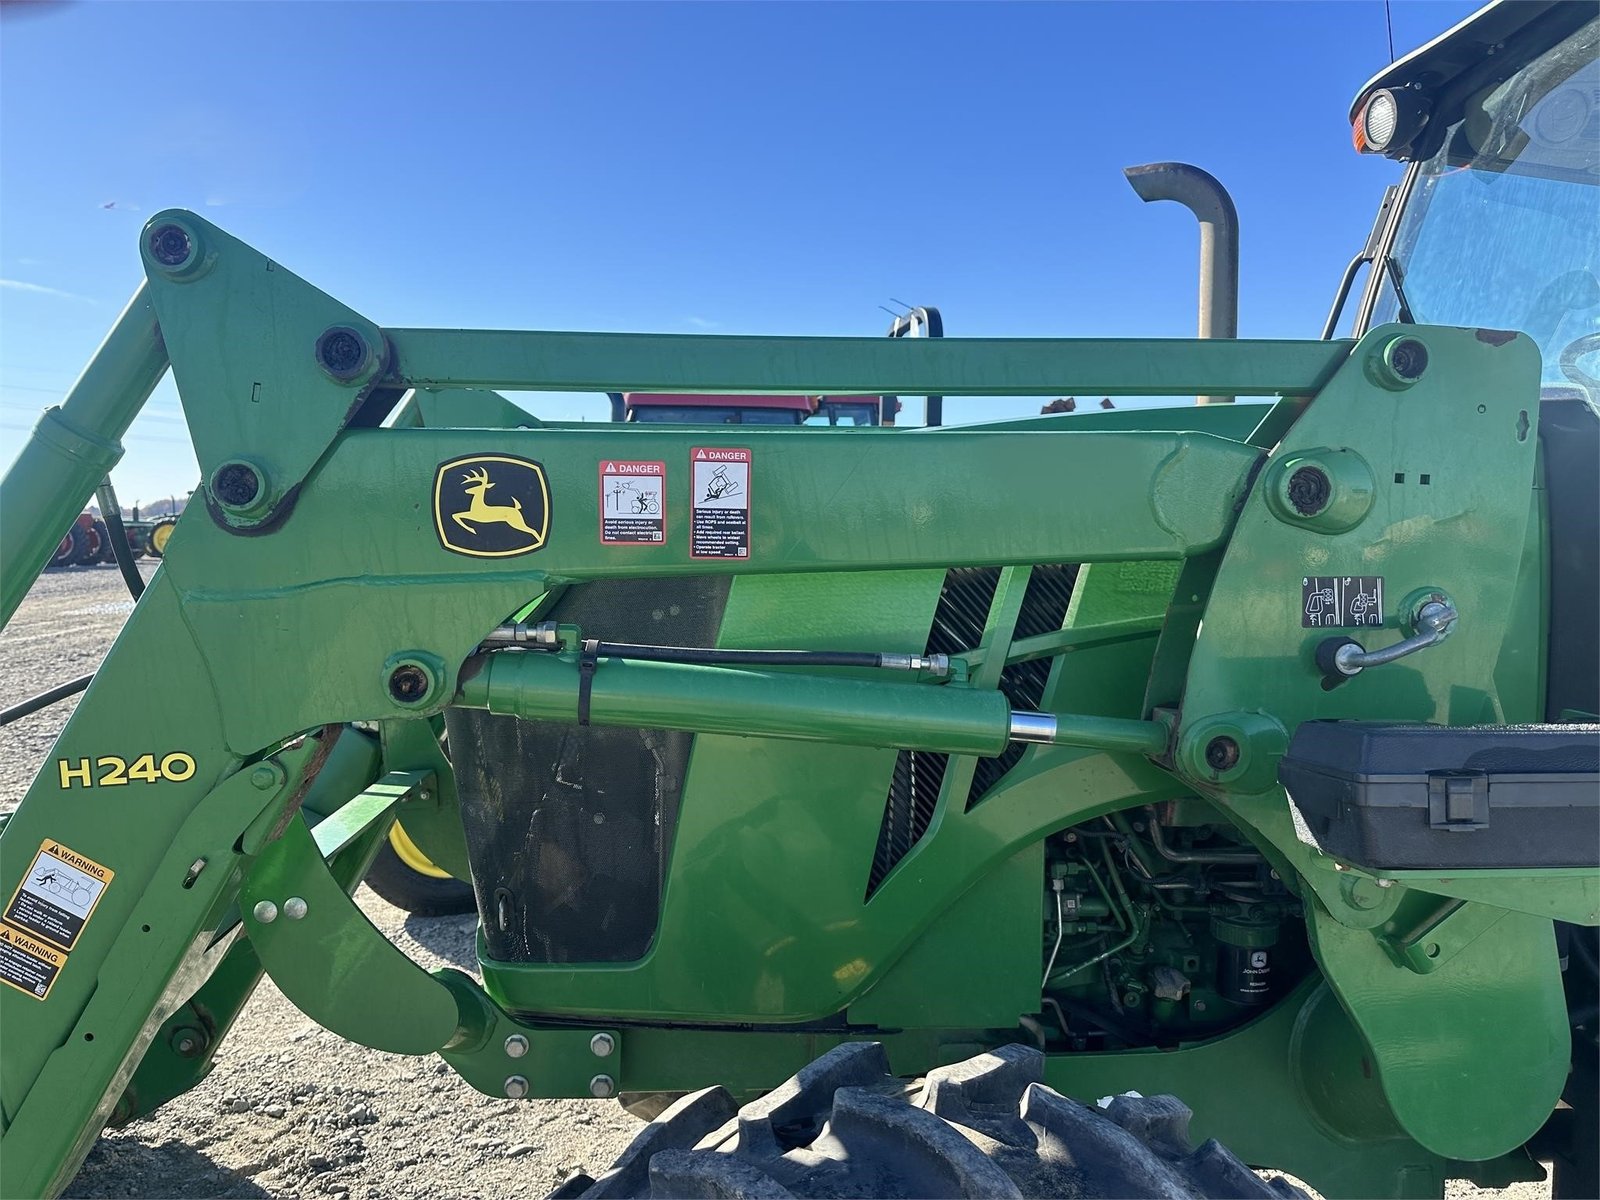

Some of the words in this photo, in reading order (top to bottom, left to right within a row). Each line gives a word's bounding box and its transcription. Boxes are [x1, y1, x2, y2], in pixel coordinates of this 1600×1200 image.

[709, 452, 746, 460] DANGER
[619, 464, 660, 473] DANGER
[60, 850, 105, 877] WARNING
[18, 906, 32, 915] service
[46, 920, 58, 928] raised
[37, 901, 48, 909] injury
[57, 911, 70, 919] falling
[16, 909, 28, 917] Lower
[28, 916, 40, 924] loader
[45, 924, 59, 933] ground
[47, 916, 62, 925] perform
[15, 936, 58, 962] WARNING
[8, 959, 22, 968] engage
[21, 965, 35, 974] retainer
[11, 953, 31, 965] attachment
[12, 948, 26, 957] operate
[26, 955, 37, 963] loader
[37, 961, 51, 969] without
[4, 961, 24, 973] attachment
[24, 971, 42, 982] detaching
[8, 968, 22, 977] causing
[22, 975, 35, 983] serious
